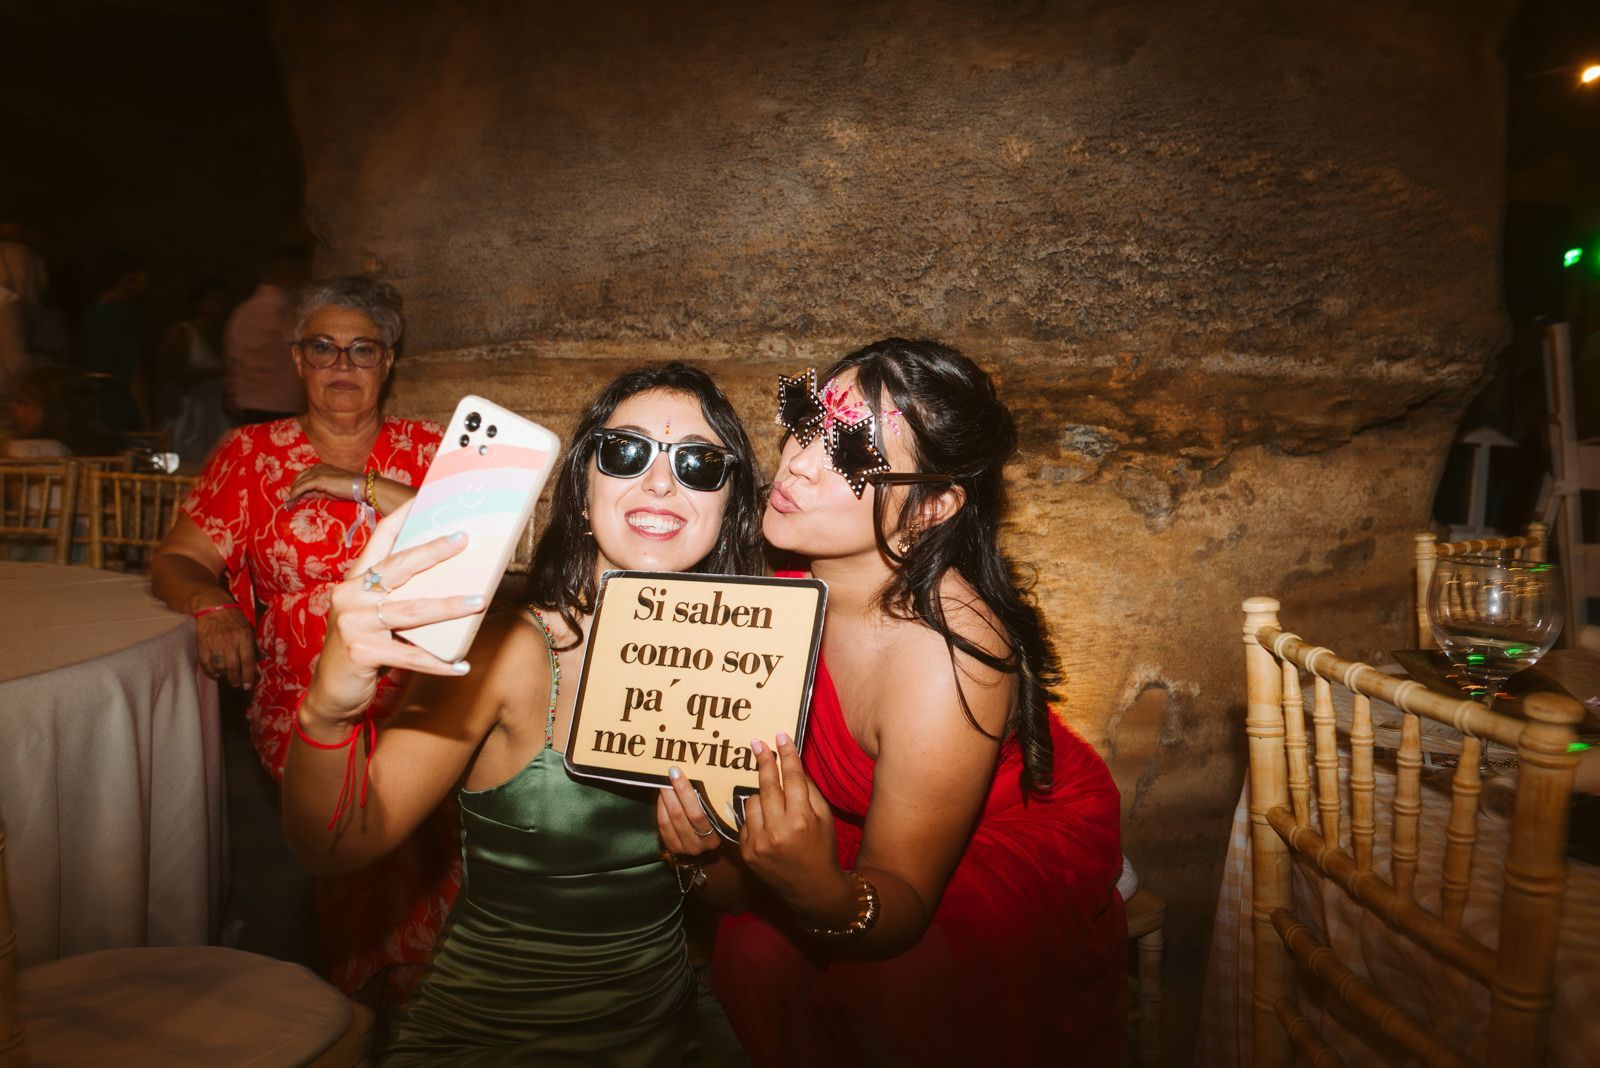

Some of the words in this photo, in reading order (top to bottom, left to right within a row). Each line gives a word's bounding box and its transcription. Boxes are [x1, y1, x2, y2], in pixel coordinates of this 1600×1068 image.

[634, 586, 667, 620] Si
[673, 591, 772, 629] saben
[620, 642, 713, 670] como
[722, 650, 783, 688] soy
[687, 694, 752, 730] que
[591, 729, 646, 756] me
